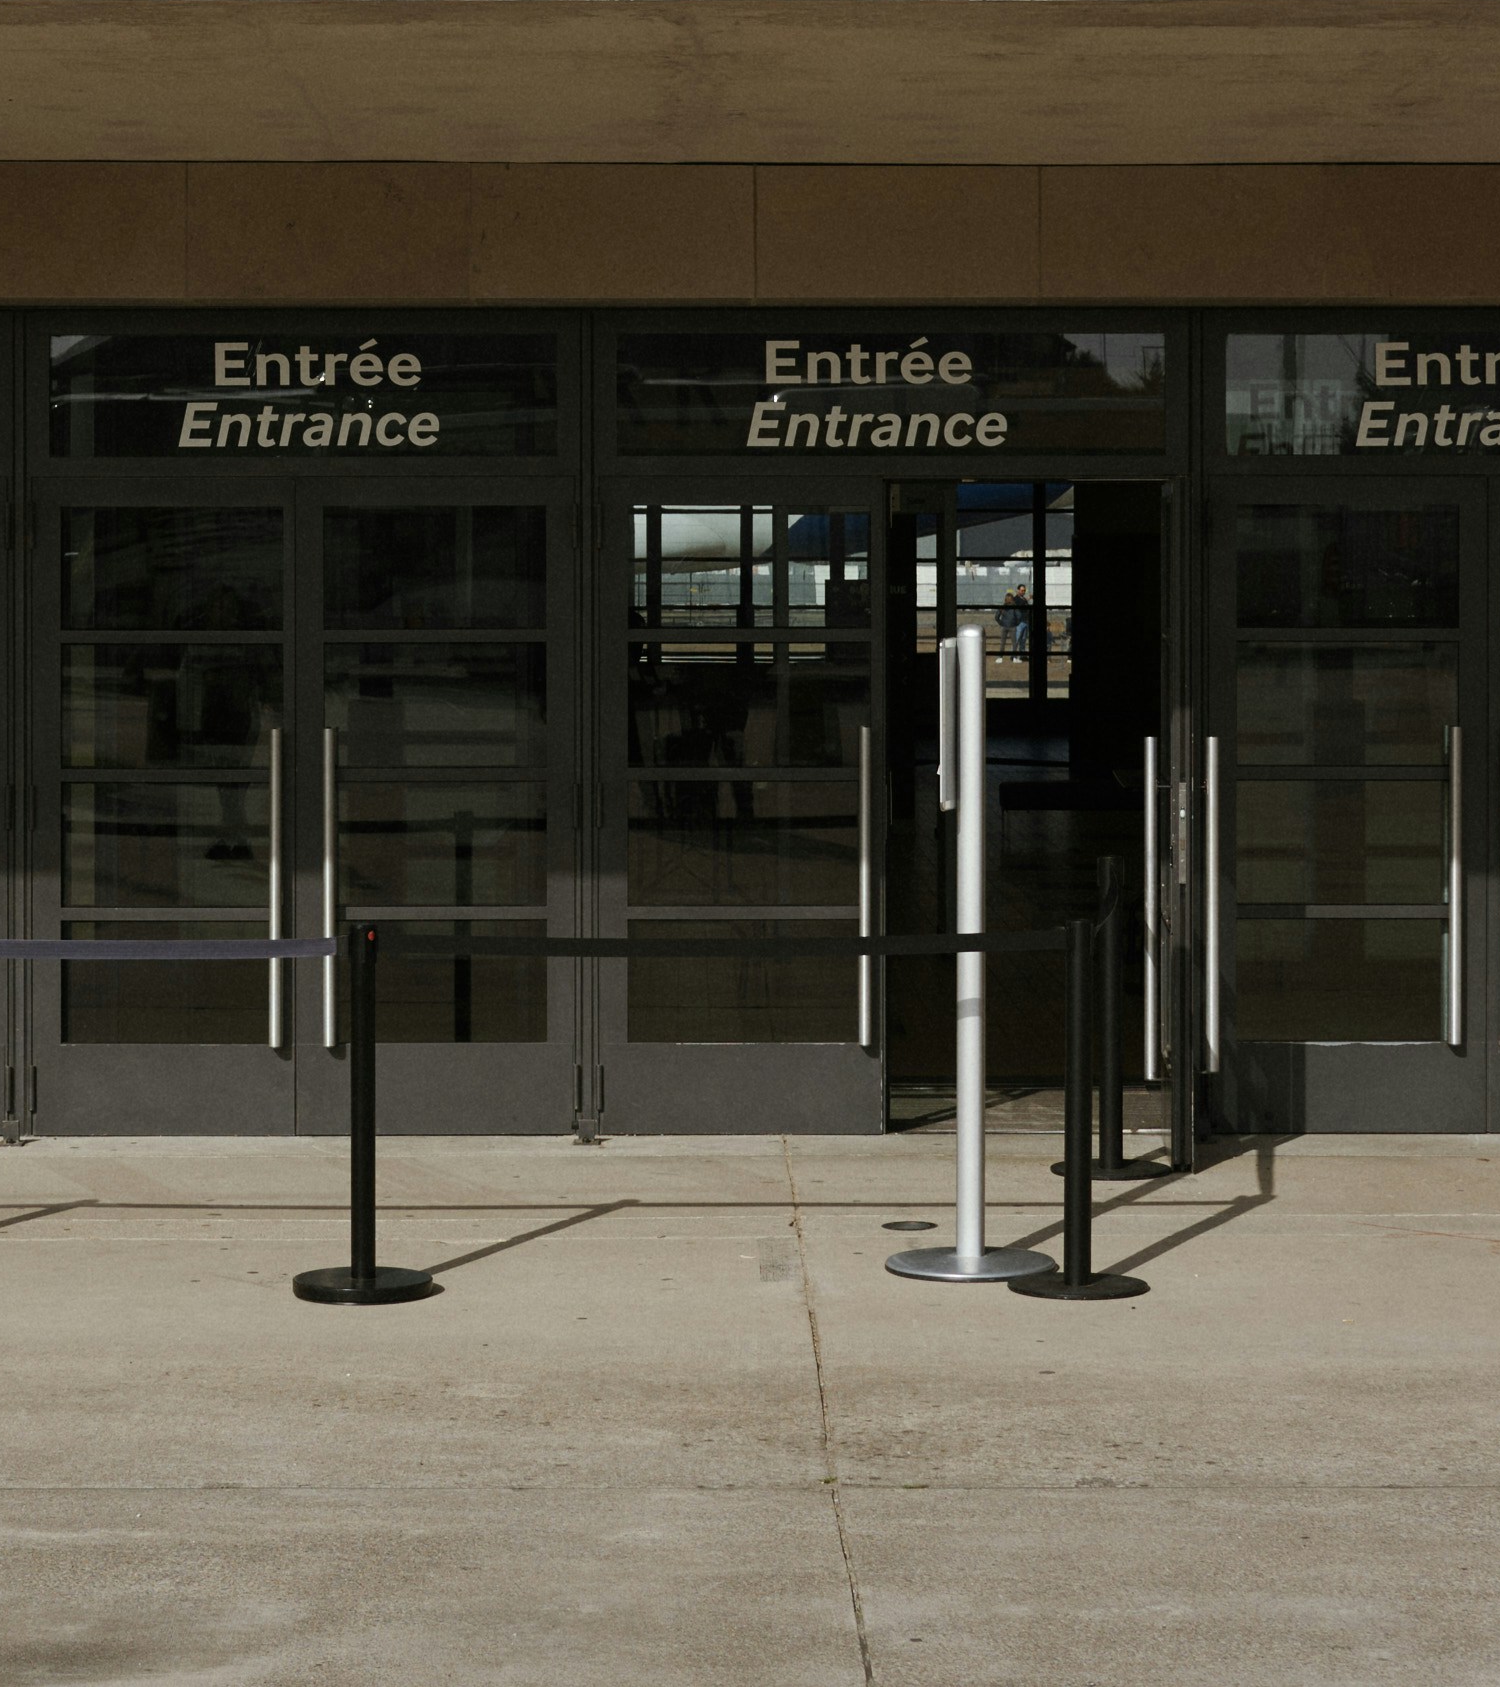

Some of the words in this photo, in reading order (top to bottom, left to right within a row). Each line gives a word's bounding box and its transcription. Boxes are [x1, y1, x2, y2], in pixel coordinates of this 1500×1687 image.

[212, 338, 423, 387] Entrée
[764, 336, 973, 385] Entrée
[178, 400, 441, 448] Entrance
[746, 400, 1009, 449] Entrance
